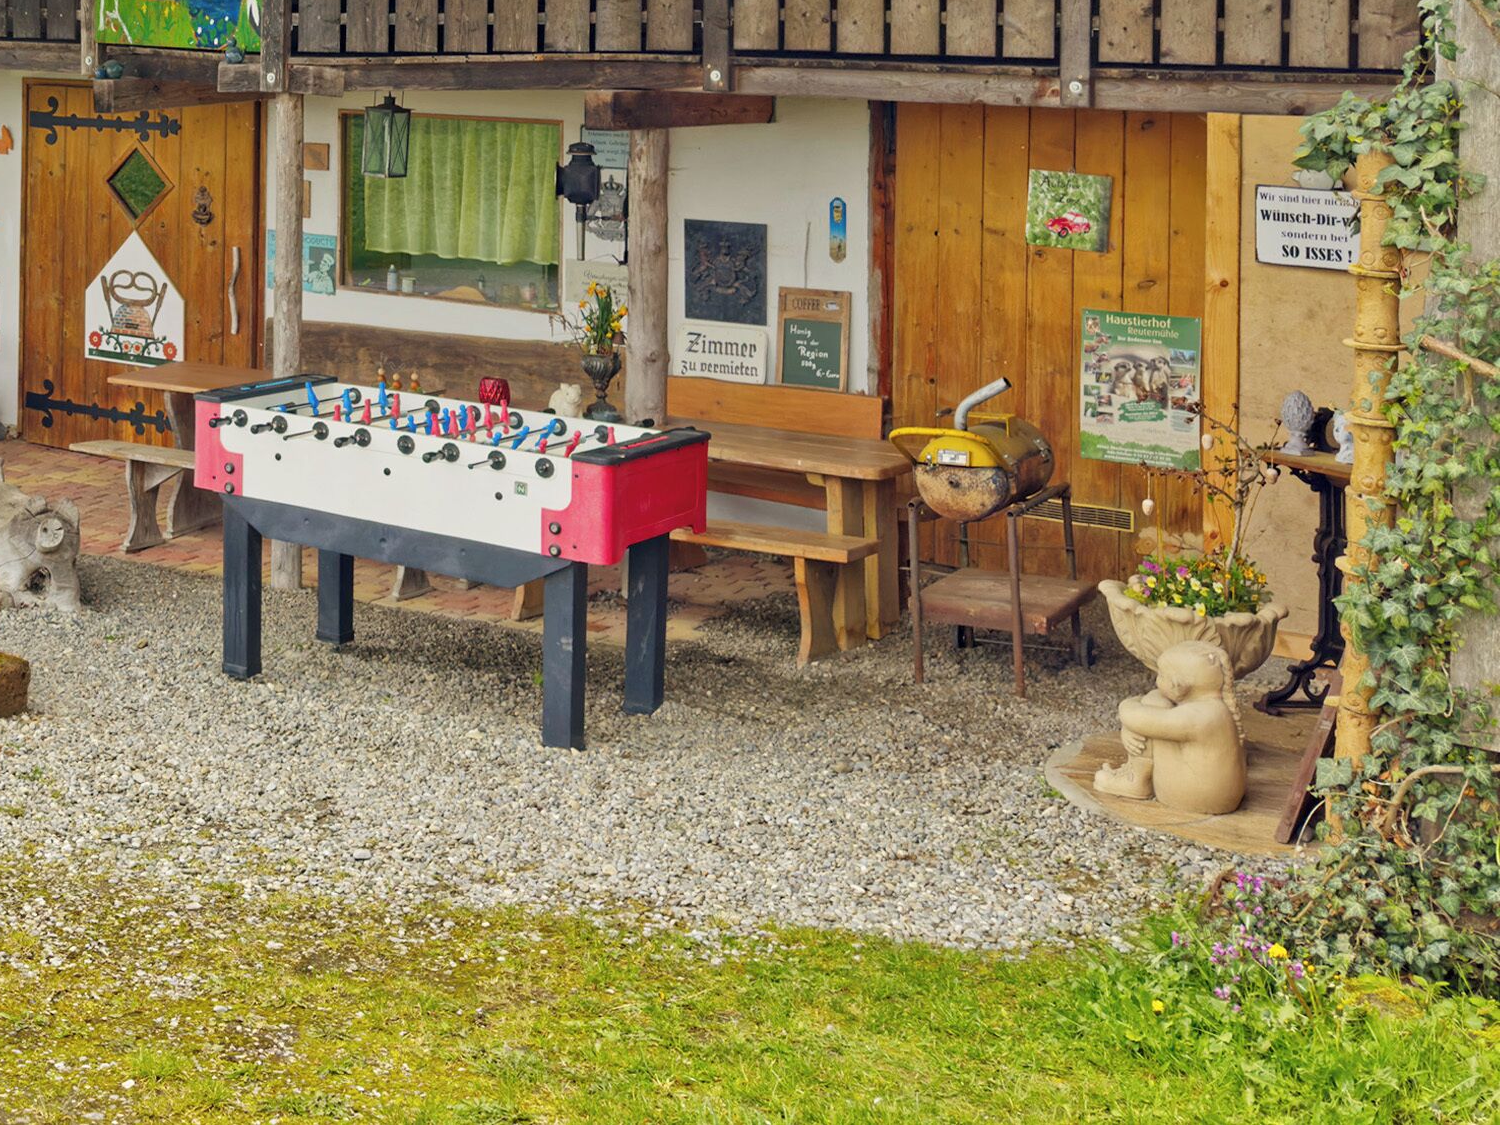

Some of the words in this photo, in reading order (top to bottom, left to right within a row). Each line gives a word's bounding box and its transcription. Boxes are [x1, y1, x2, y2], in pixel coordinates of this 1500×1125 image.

[1260, 192, 1275, 202] Wir
[1278, 194, 1299, 205] sind
[1301, 195, 1321, 205] hier
[1281, 230, 1327, 241] sondern
[1330, 232, 1349, 243] bei
[1281, 244, 1300, 259] SO
[1305, 246, 1343, 263] ISSES
[1347, 250, 1353, 263] !
[792, 297, 821, 311] COFFEE
[1106, 313, 1172, 329] Haustierhof
[789, 324, 812, 338] Honig
[1127, 326, 1180, 340] Reutemühle
[686, 332, 757, 358] Zimmer
[797, 345, 829, 360] Region
[681, 360, 697, 375] zu
[700, 361, 759, 377] vermieten
